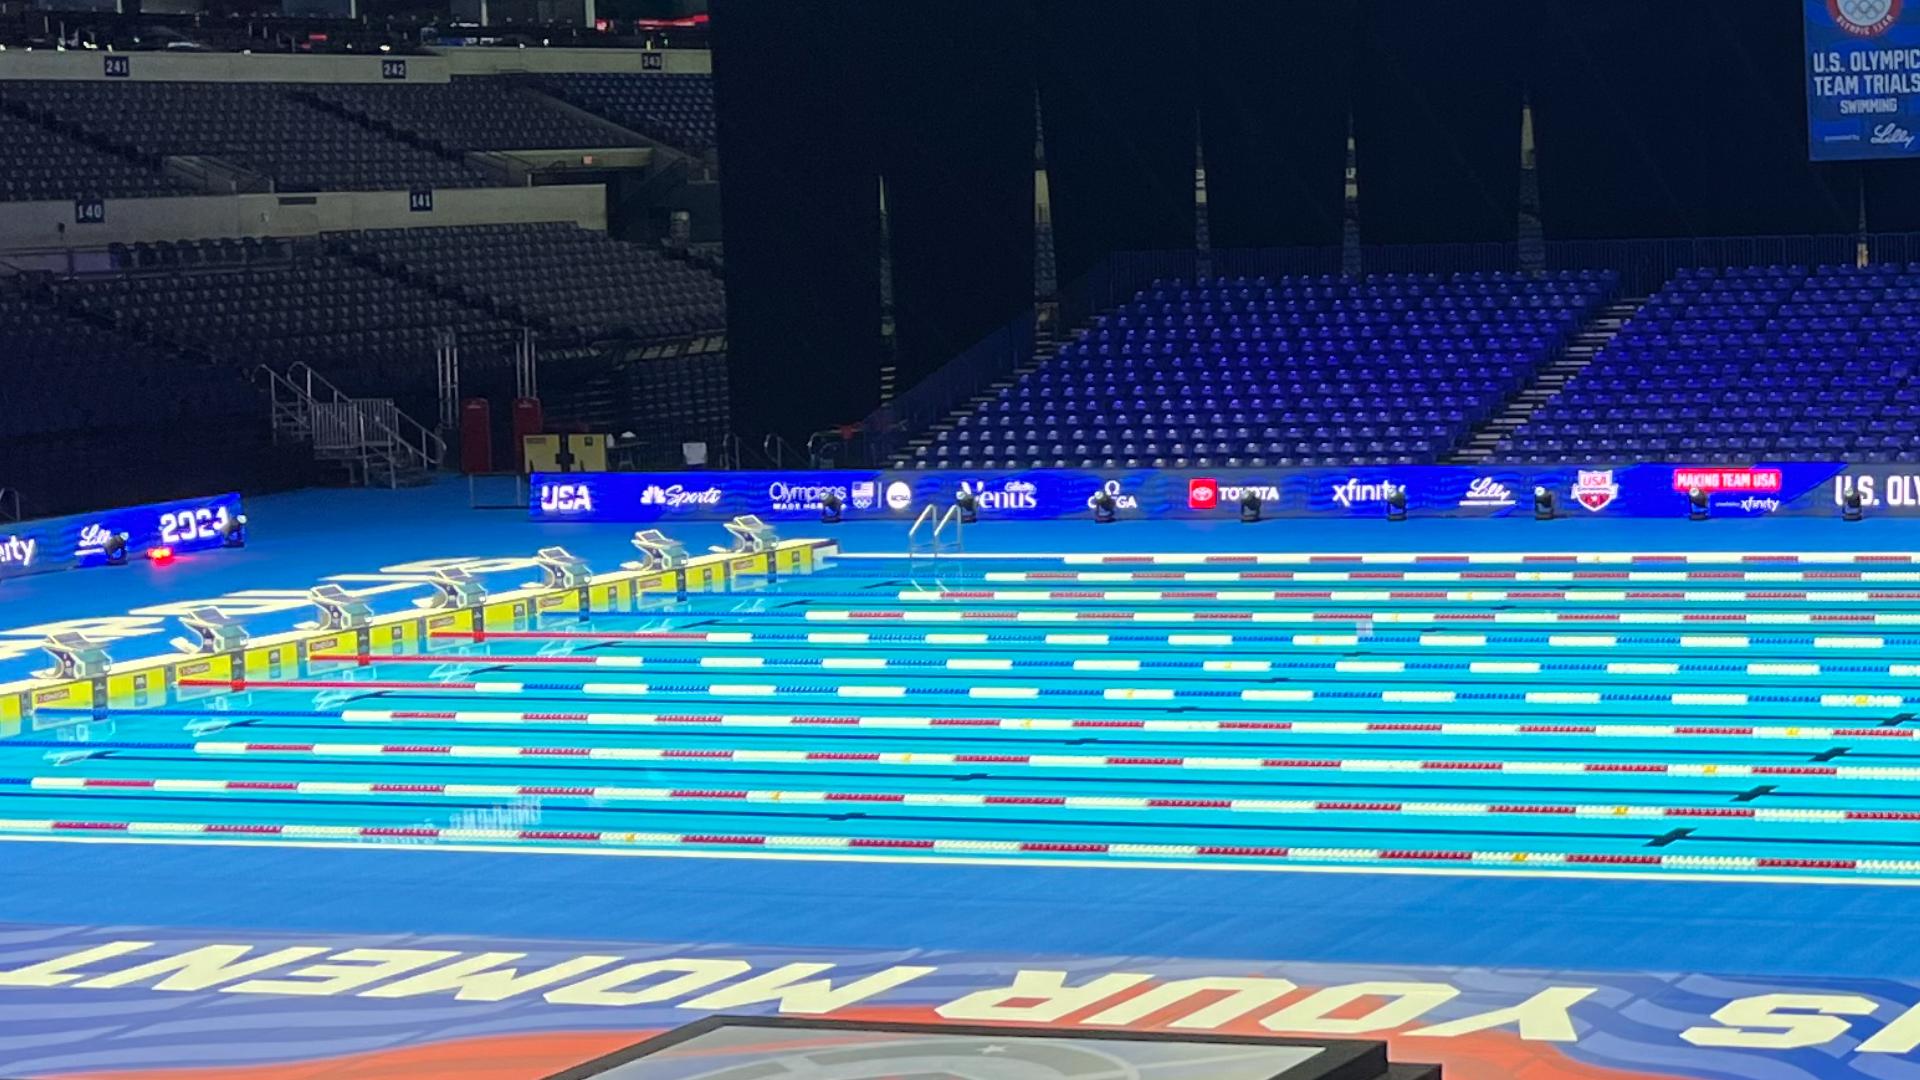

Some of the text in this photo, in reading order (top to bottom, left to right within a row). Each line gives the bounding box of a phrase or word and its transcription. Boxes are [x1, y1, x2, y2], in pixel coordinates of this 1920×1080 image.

[106, 60, 127, 73] 241
[384, 63, 405, 75] 242
[1813, 49, 1920, 73] U.S. OLYMPIC
[1813, 73, 1920, 96] TEAM TRIALS
[1840, 98, 1898, 115] SWIMMING
[412, 194, 430, 207] 141
[78, 204, 102, 219] 140
[1582, 476, 1607, 486] USA
[1677, 472, 1777, 488] MAKING TEAM USA
[541, 485, 592, 511] USA
[665, 484, 722, 507] Sports
[1332, 478, 1406, 507] xfinit
[1834, 475, 1880, 506] US.
[1087, 495, 1138, 509] OGA
[1740, 496, 1780, 512] xfinity
[0, 940, 938, 1014] MOMENT
[934, 969, 1598, 1042] YOUR
